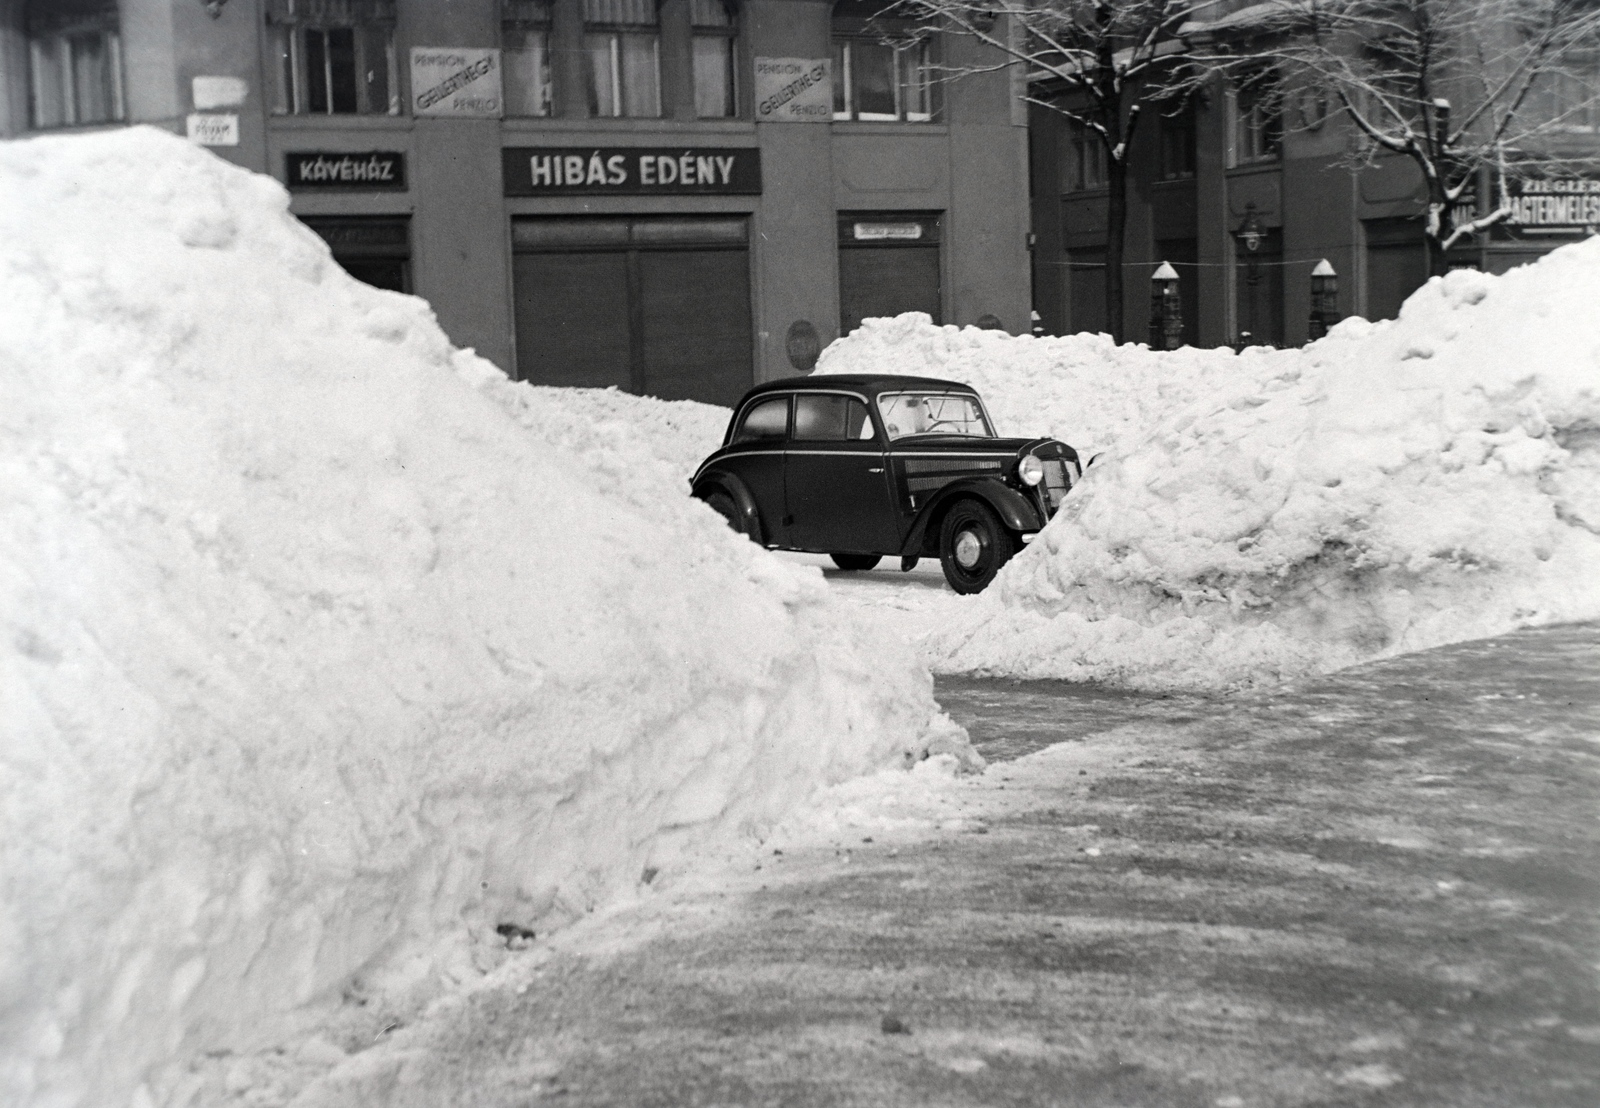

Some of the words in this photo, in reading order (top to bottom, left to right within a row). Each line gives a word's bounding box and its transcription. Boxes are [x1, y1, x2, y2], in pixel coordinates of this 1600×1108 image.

[757, 64, 802, 75] PENSION
[300, 154, 394, 181] KÁVÉHÁZ
[530, 150, 628, 186] HIBÁS
[639, 150, 735, 185] EDÉNY
